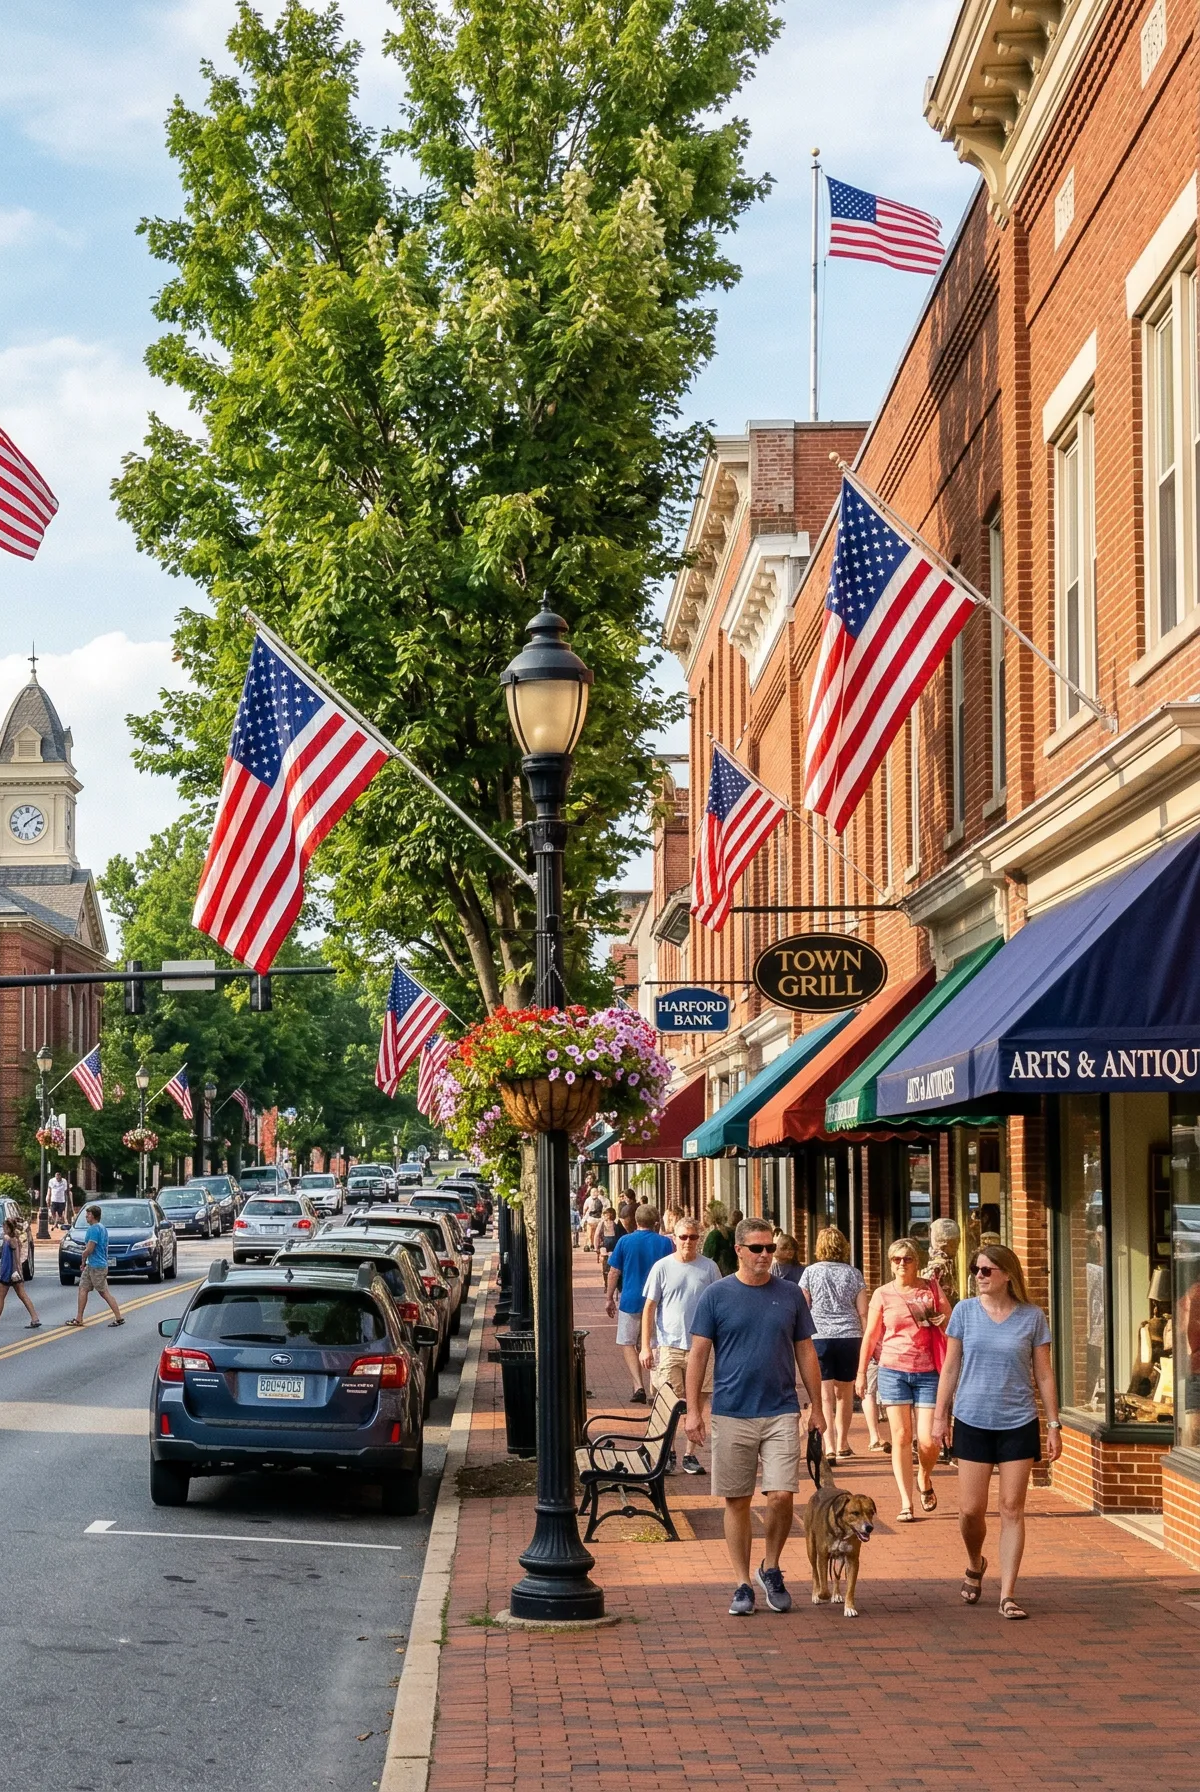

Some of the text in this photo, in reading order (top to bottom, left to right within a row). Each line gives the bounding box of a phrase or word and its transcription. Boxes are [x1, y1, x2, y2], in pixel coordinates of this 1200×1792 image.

[775, 950, 862, 971] TOWN
[778, 975, 863, 997] GRILL
[658, 1001, 727, 1013] HARFORD
[674, 1015, 713, 1026] BANK
[1009, 1048, 1200, 1084] ARTS & ANTIQU
